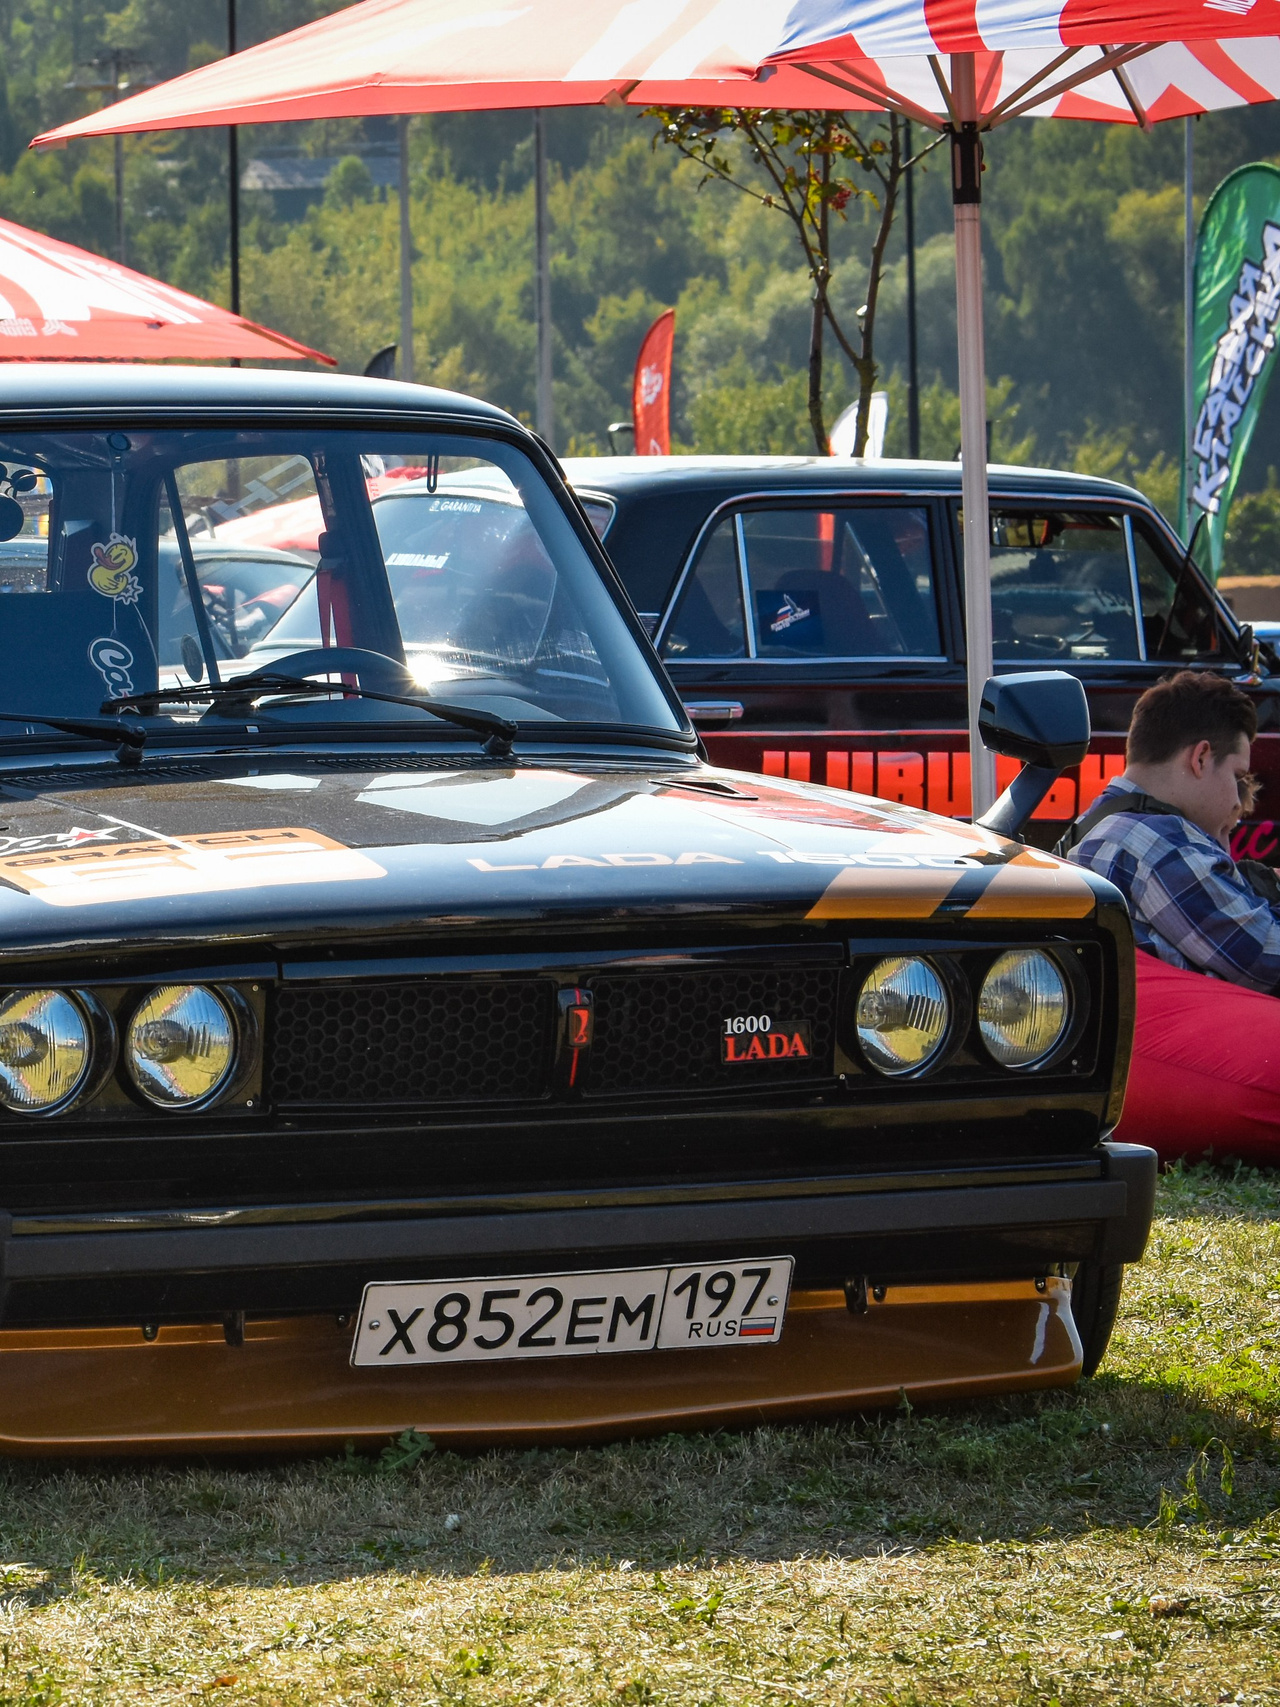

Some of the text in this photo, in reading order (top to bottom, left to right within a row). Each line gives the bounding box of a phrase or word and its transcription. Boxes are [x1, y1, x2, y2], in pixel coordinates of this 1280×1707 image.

[3, 830, 301, 868] GRATCH
[466, 849, 986, 872] LADA 1600
[723, 1014, 772, 1035] 1600
[724, 1032, 809, 1062] LADA
[672, 1267, 772, 1320] 197
[687, 1319, 738, 1339] RUS
